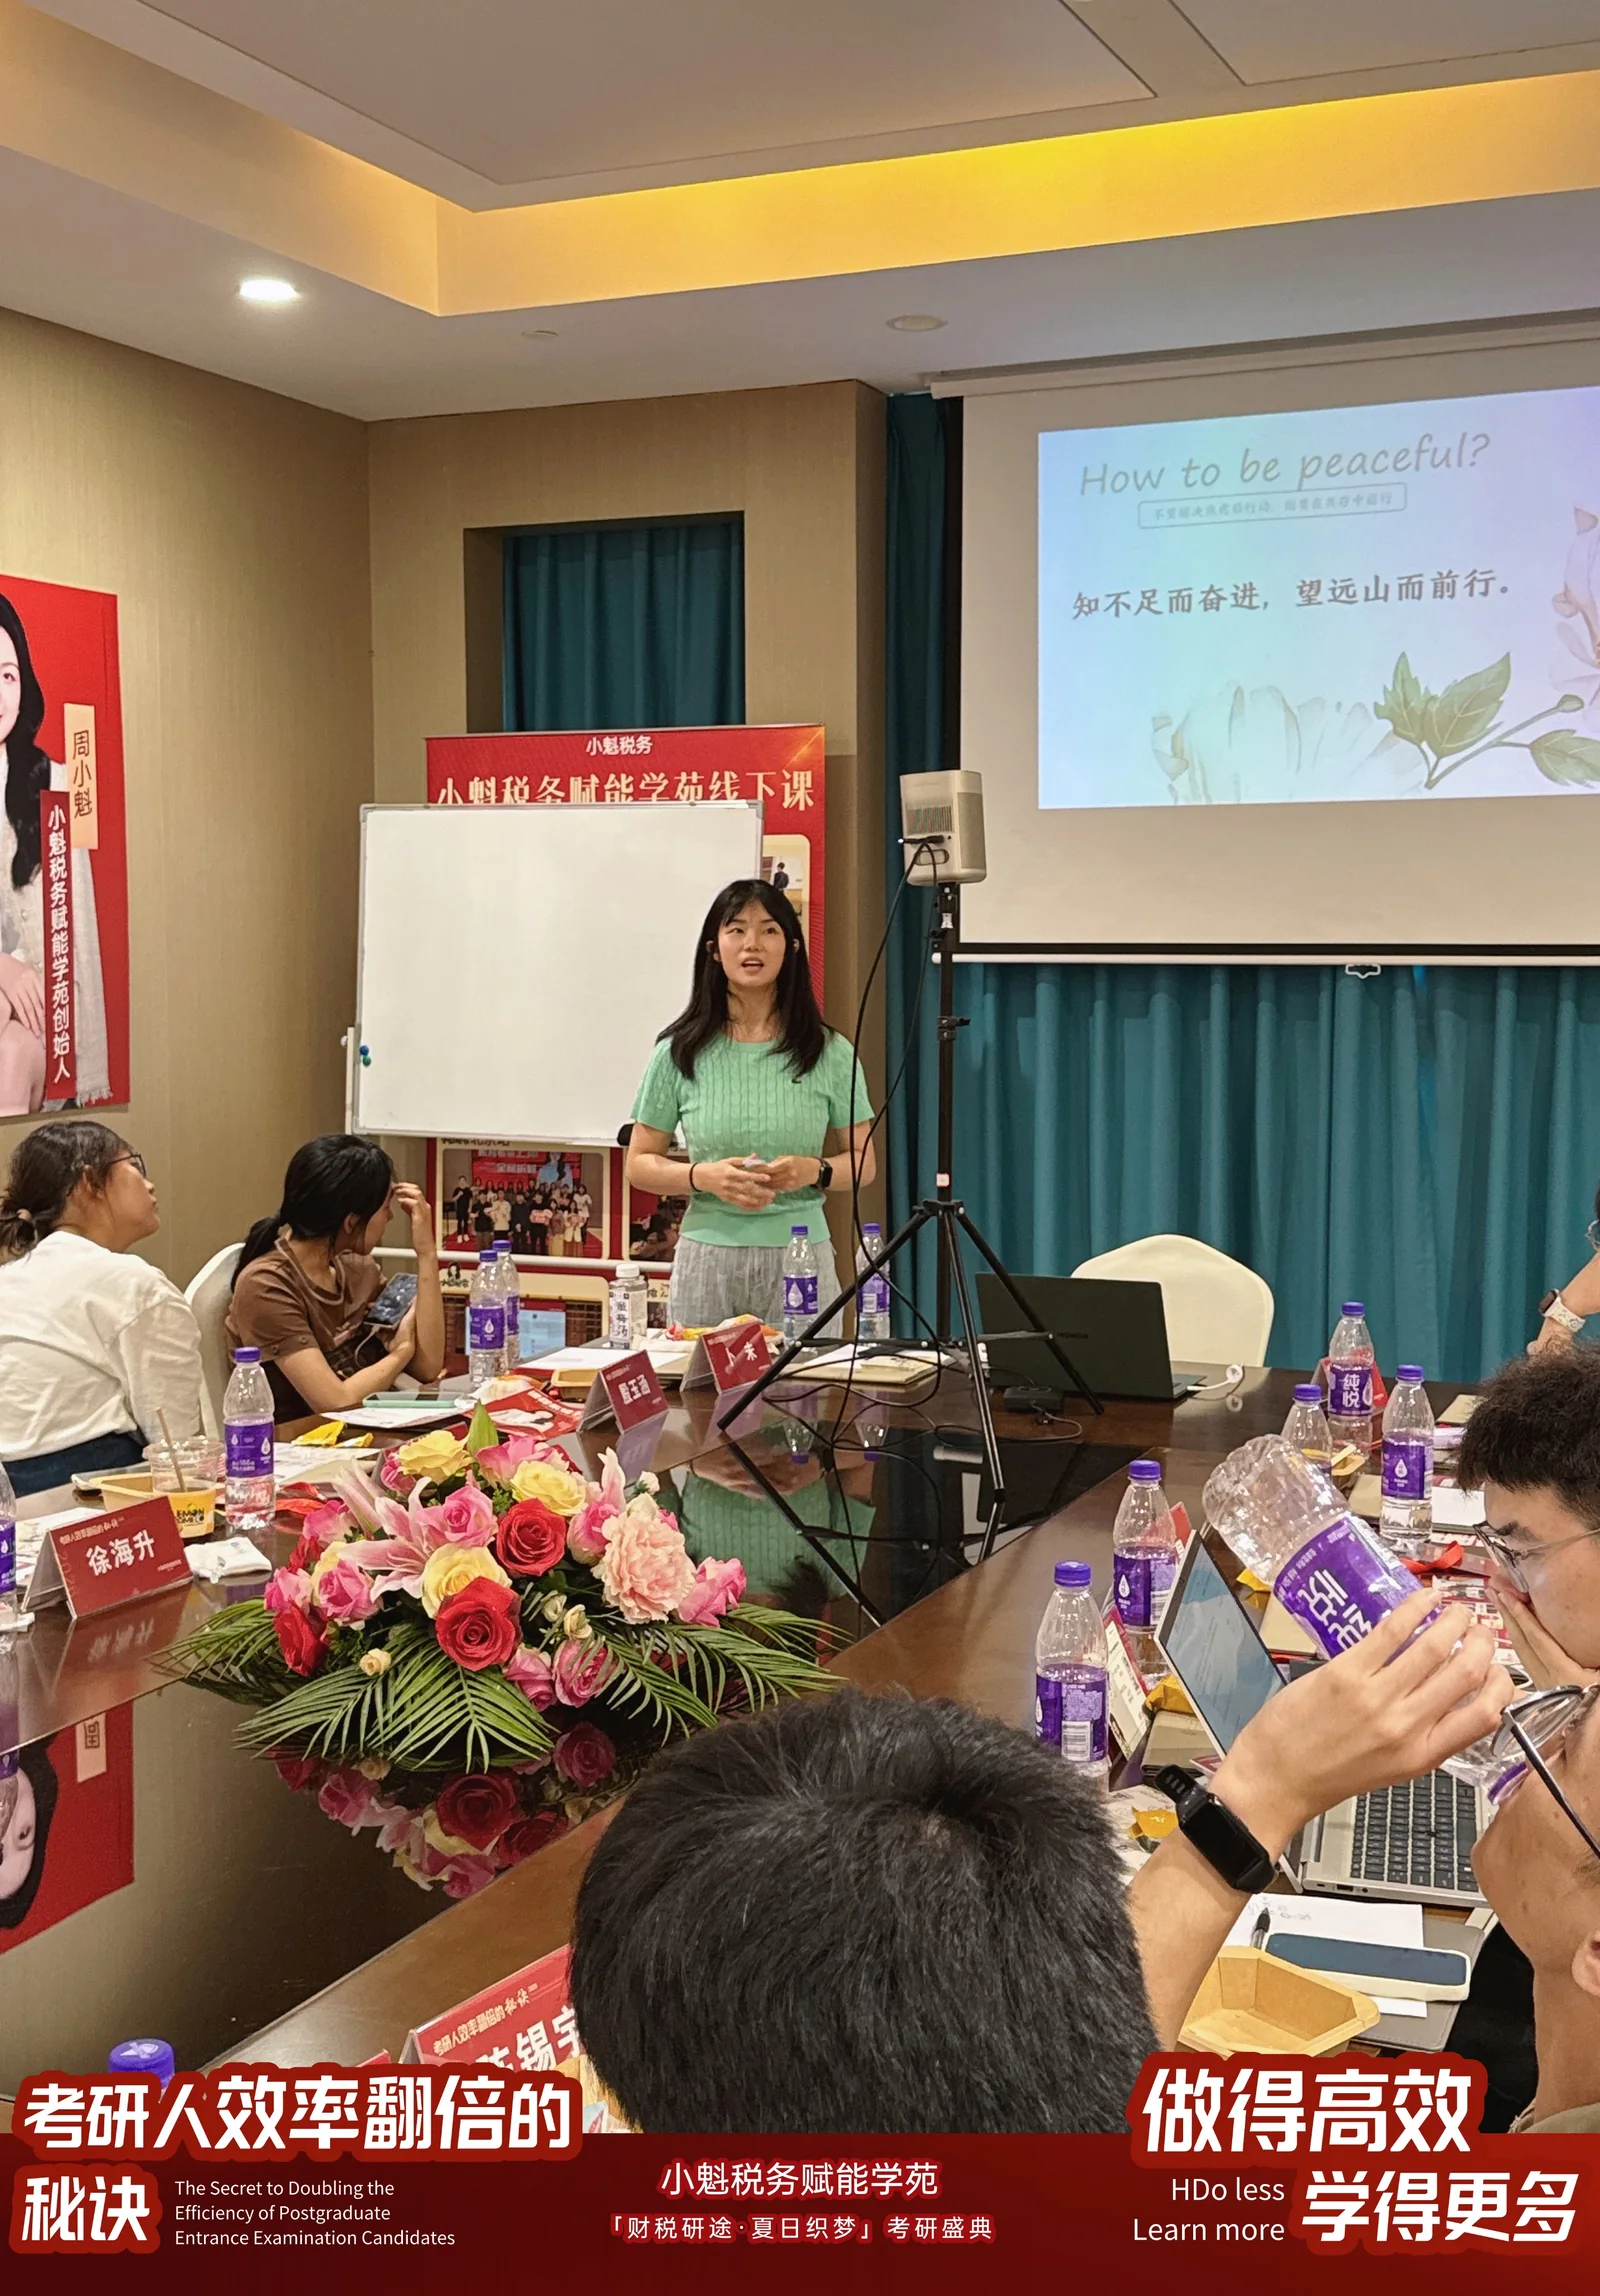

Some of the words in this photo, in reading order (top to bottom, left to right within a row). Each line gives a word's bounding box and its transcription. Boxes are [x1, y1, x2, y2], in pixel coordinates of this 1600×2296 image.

[1080, 463, 1166, 497] How
[1182, 457, 1221, 489] to
[1239, 446, 1281, 484] be
[1297, 431, 1492, 492] peaceful?
[1072, 567, 1511, 621] 知不足而奋进，望远山而前行。
[586, 735, 654, 756] 小魁税务
[72, 729, 93, 818] 周小魁
[47, 804, 72, 1084] 小魁税务赋能学苑创始人
[1342, 1373, 1360, 1408] 纯悦
[86, 1529, 155, 1576] 徐海升
